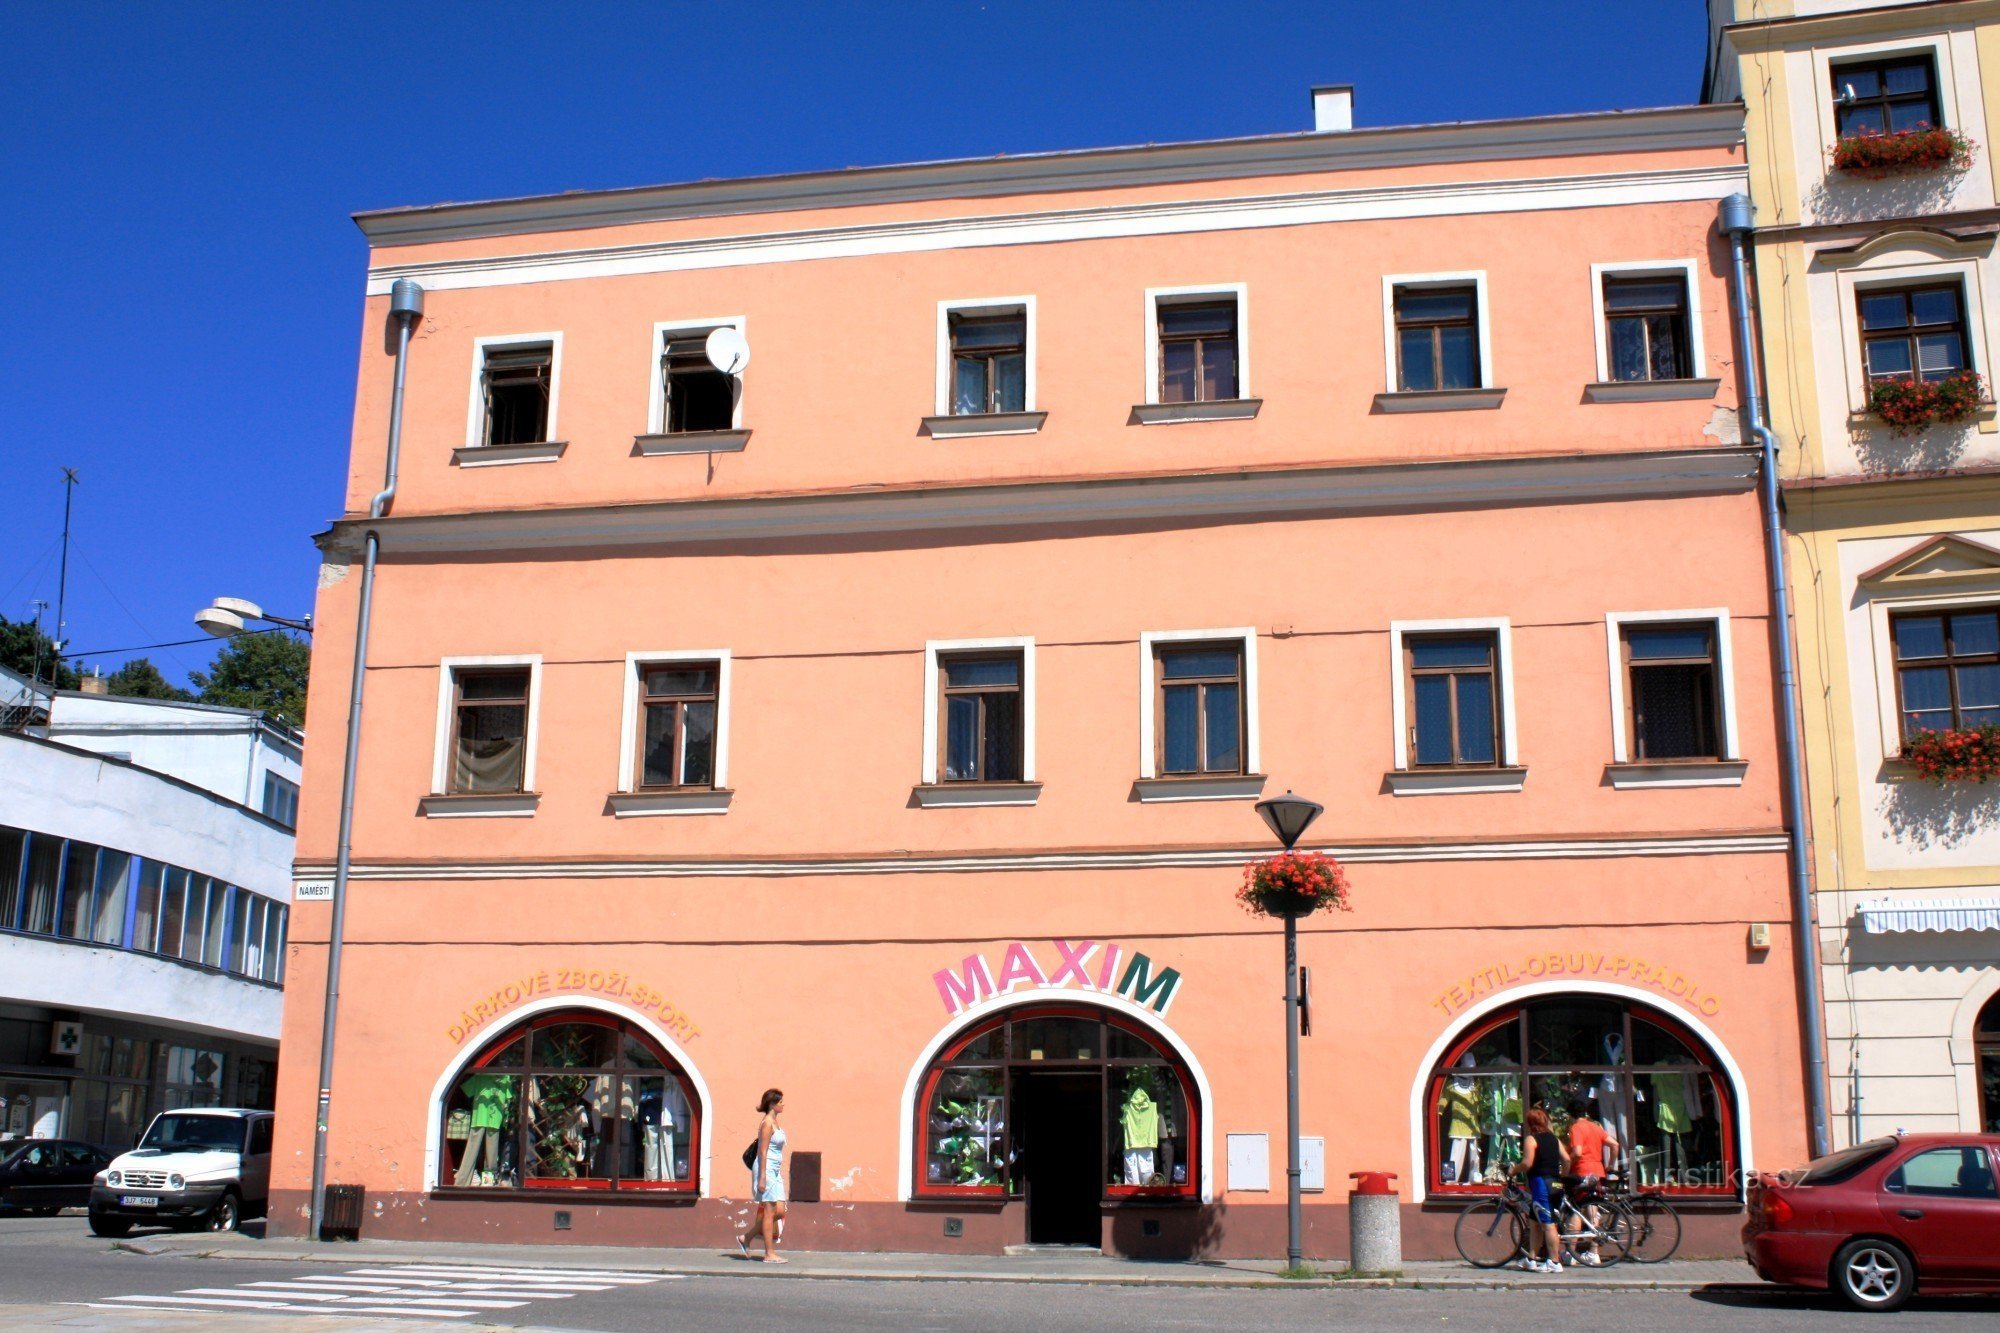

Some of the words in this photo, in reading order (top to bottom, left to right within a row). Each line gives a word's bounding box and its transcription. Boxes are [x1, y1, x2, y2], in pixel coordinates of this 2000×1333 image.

[299, 884, 330, 896] NÁMĚSTÍ
[447, 970, 550, 1044] DÁRKOVÉ
[557, 967, 700, 1044] ZBOŽÍ-SPORT
[932, 940, 1183, 1020] MAXIM
[1431, 951, 1721, 1018] TEXTIL-OBUV-PRÁDLO
